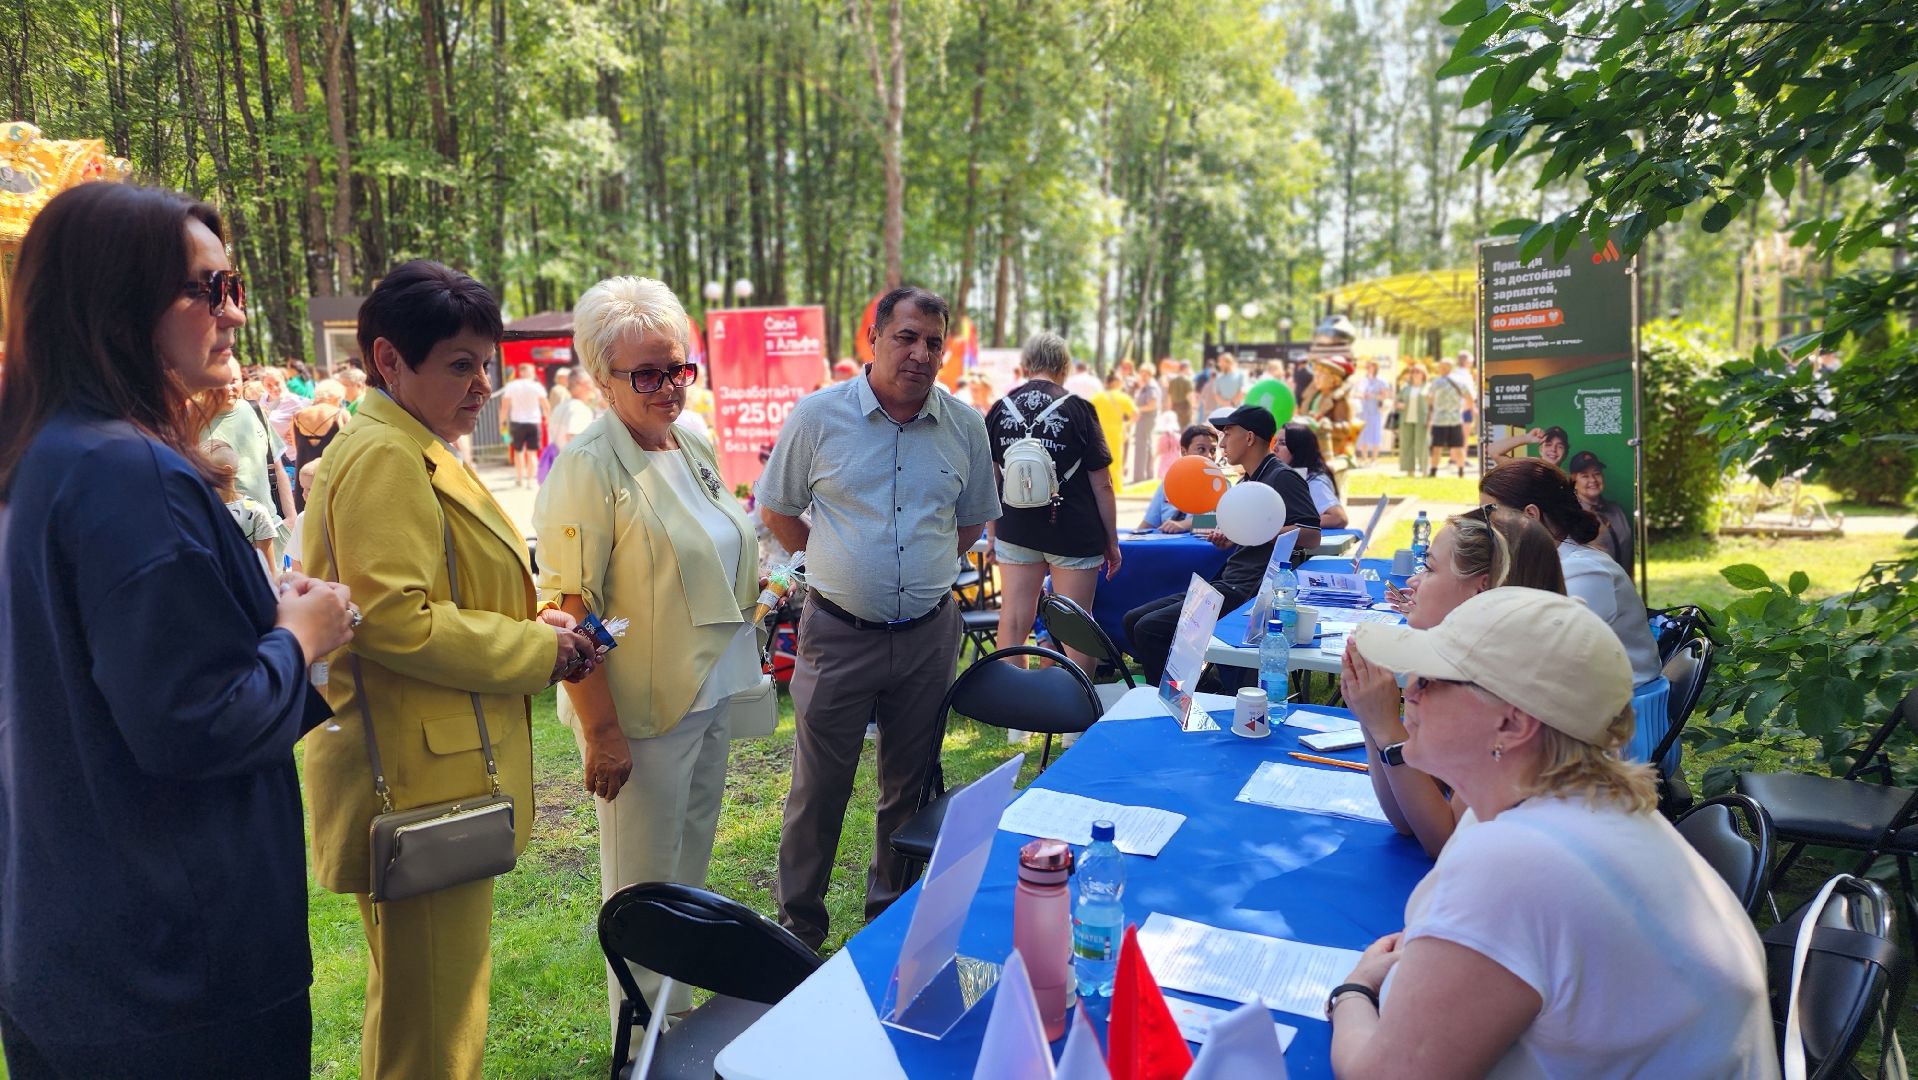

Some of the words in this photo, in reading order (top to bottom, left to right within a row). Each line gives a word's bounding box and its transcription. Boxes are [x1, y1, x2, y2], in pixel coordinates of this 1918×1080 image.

[1493, 257, 1542, 273] Прихди
[1493, 277, 1506, 286] за
[1508, 264, 1571, 286] достойной
[1493, 281, 1558, 301] зарплатой,
[1493, 298, 1553, 313] оставайся
[763, 316, 797, 331] Свой
[1493, 319, 1507, 328] по
[1507, 314, 1546, 328] любви
[765, 340, 775, 350] в
[776, 336, 820, 352] Альфе
[721, 405, 737, 416] от
